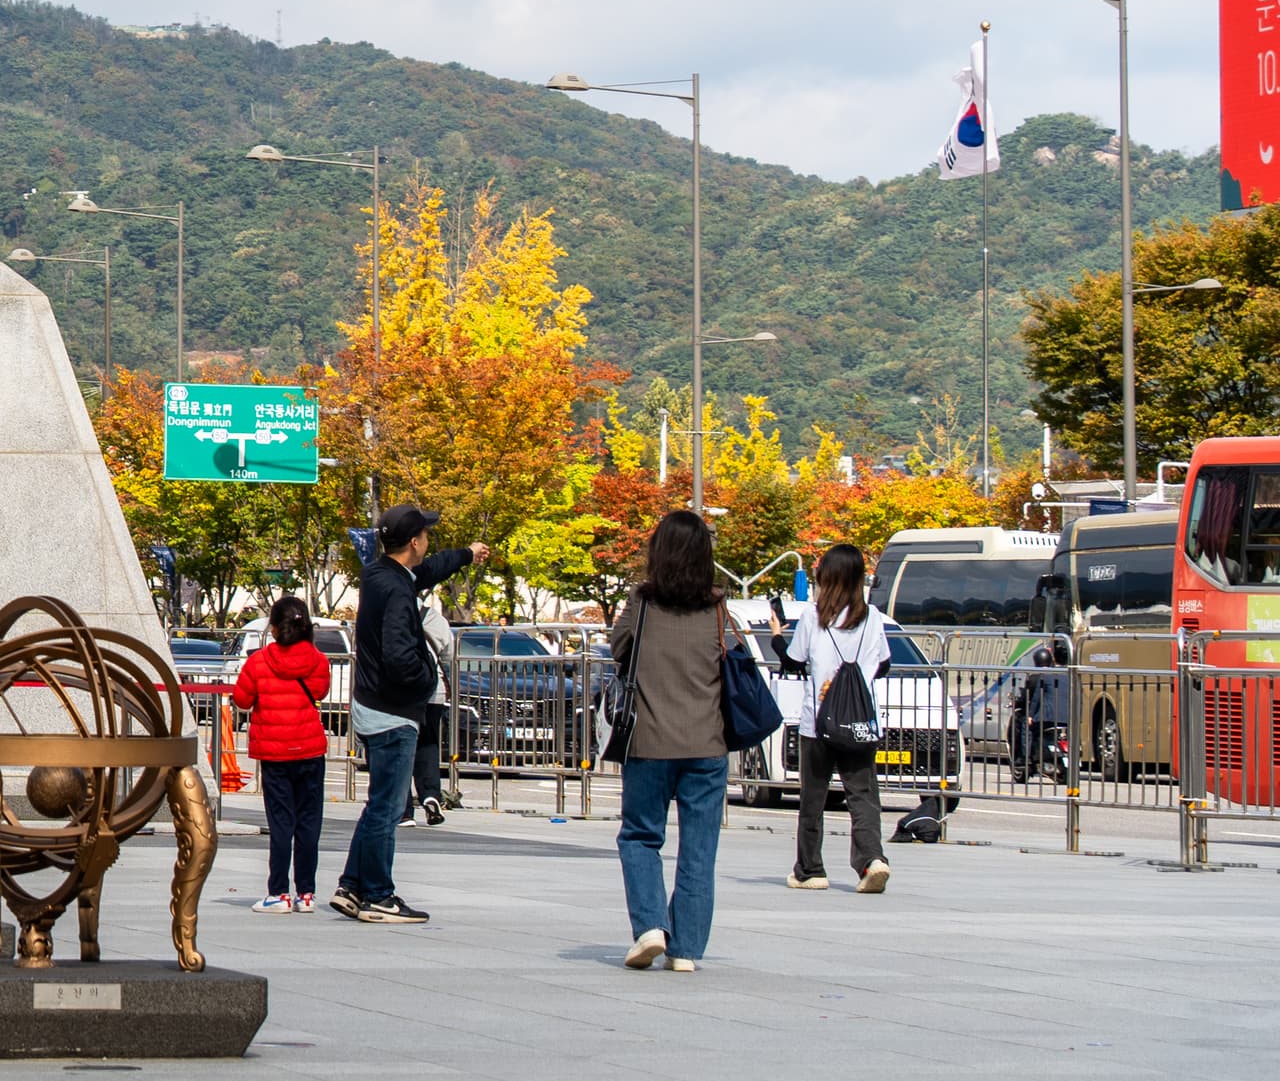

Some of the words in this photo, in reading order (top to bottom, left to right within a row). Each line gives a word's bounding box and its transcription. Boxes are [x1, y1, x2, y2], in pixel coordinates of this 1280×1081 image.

[168, 401, 200, 416] 독립문
[254, 404, 315, 419] 안국동사거리
[167, 417, 232, 428] Dongnimmun
[255, 420, 301, 432] Angukdong
[230, 469, 258, 479] 140m
